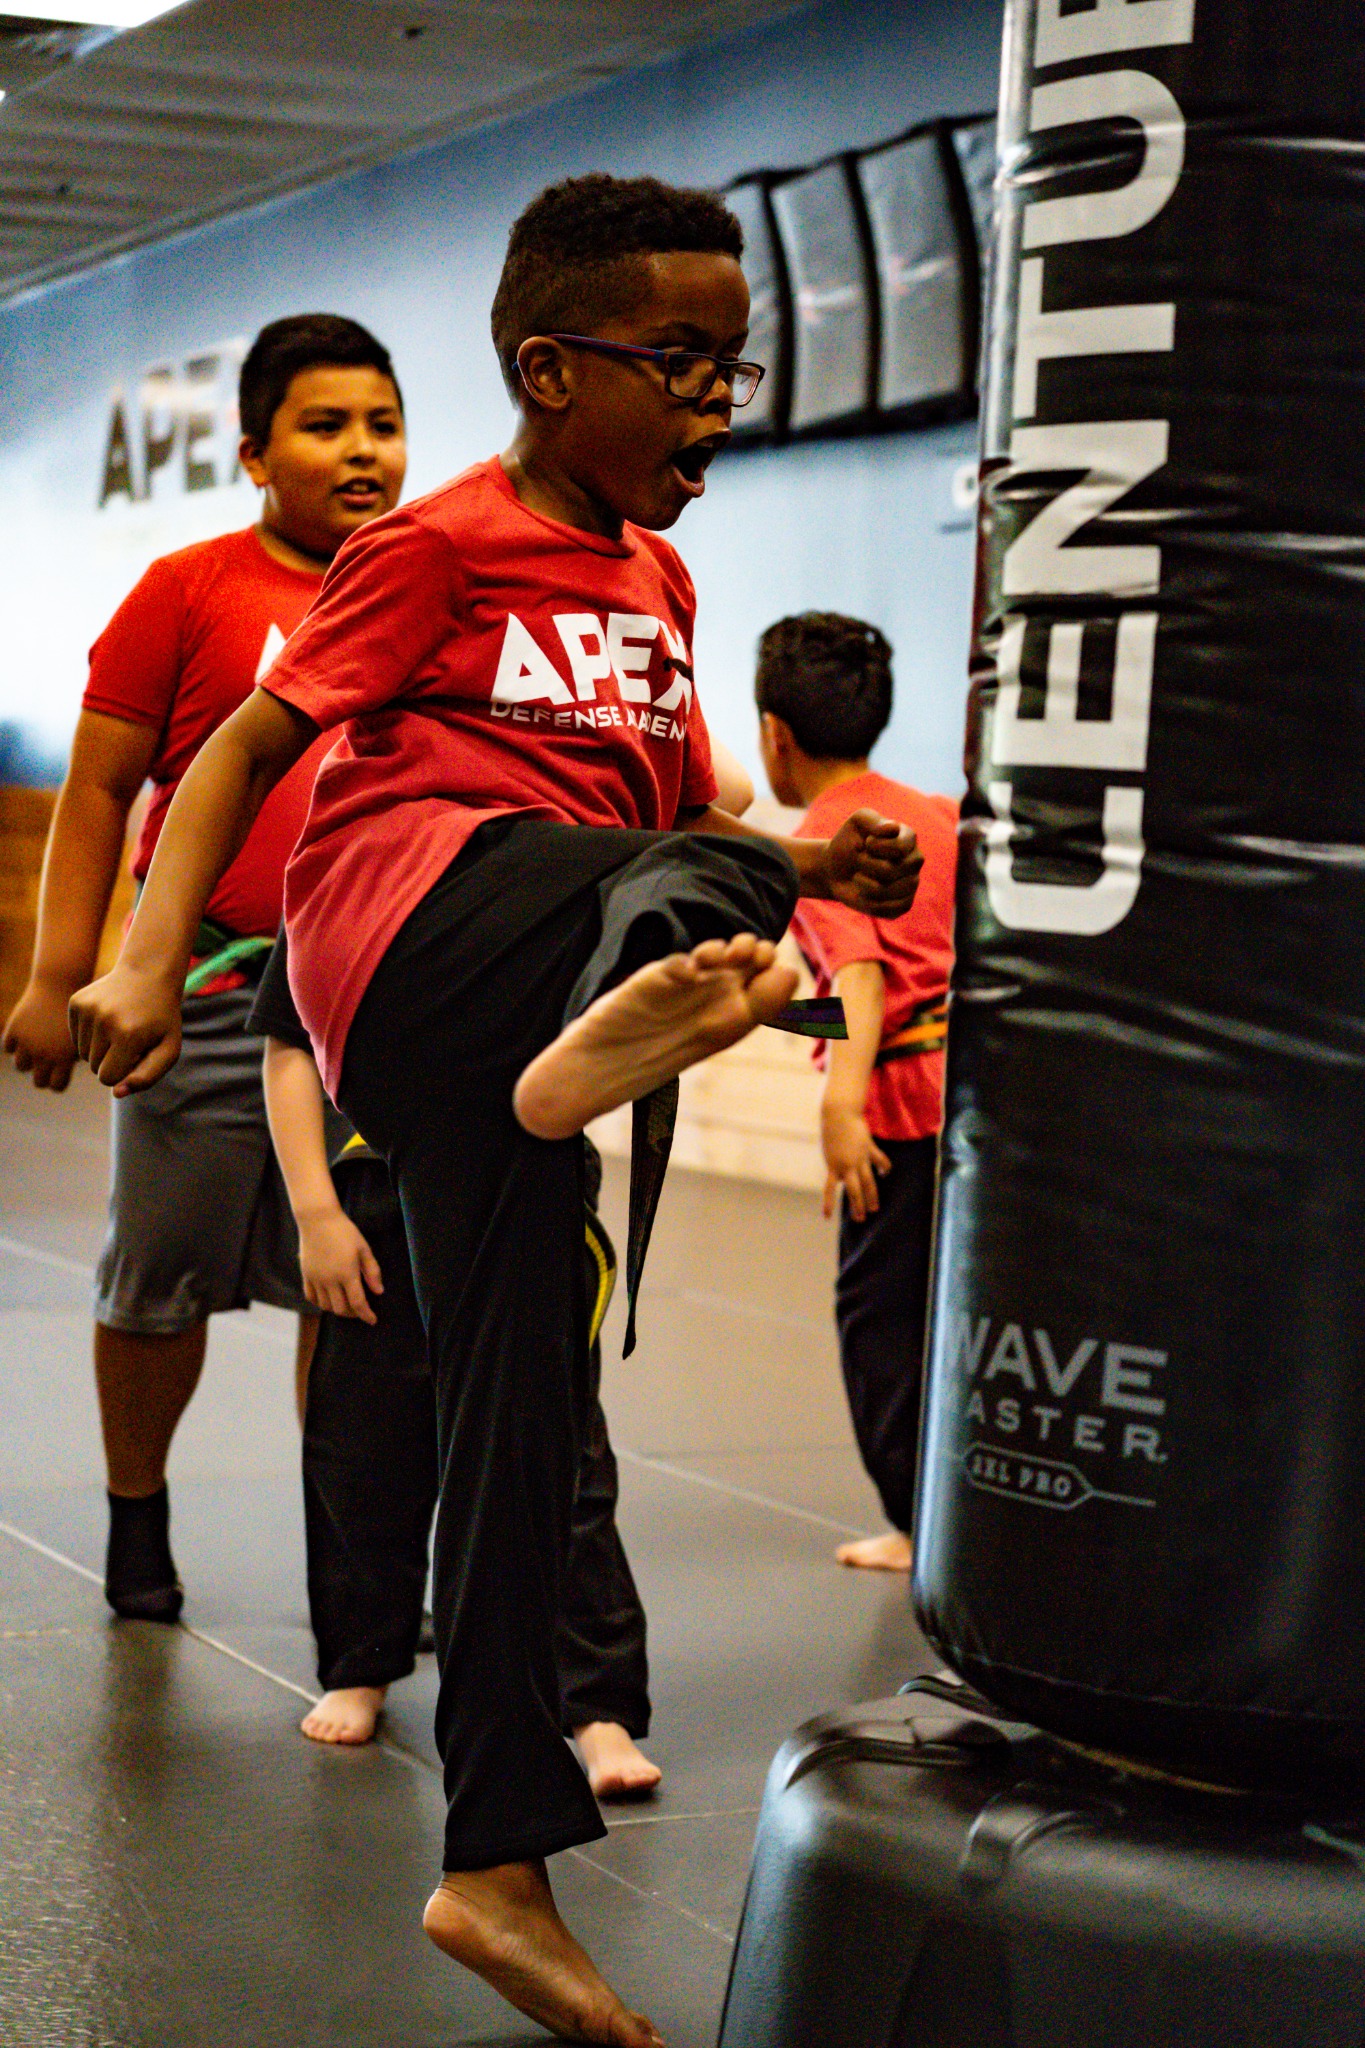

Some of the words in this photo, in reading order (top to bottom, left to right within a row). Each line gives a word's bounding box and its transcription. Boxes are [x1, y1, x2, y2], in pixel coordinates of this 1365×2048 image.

[98, 350, 243, 510] APE
[490, 612, 693, 714] APEX
[490, 701, 623, 729] DEFENSE
[962, 1390, 1166, 1463] ASTER
